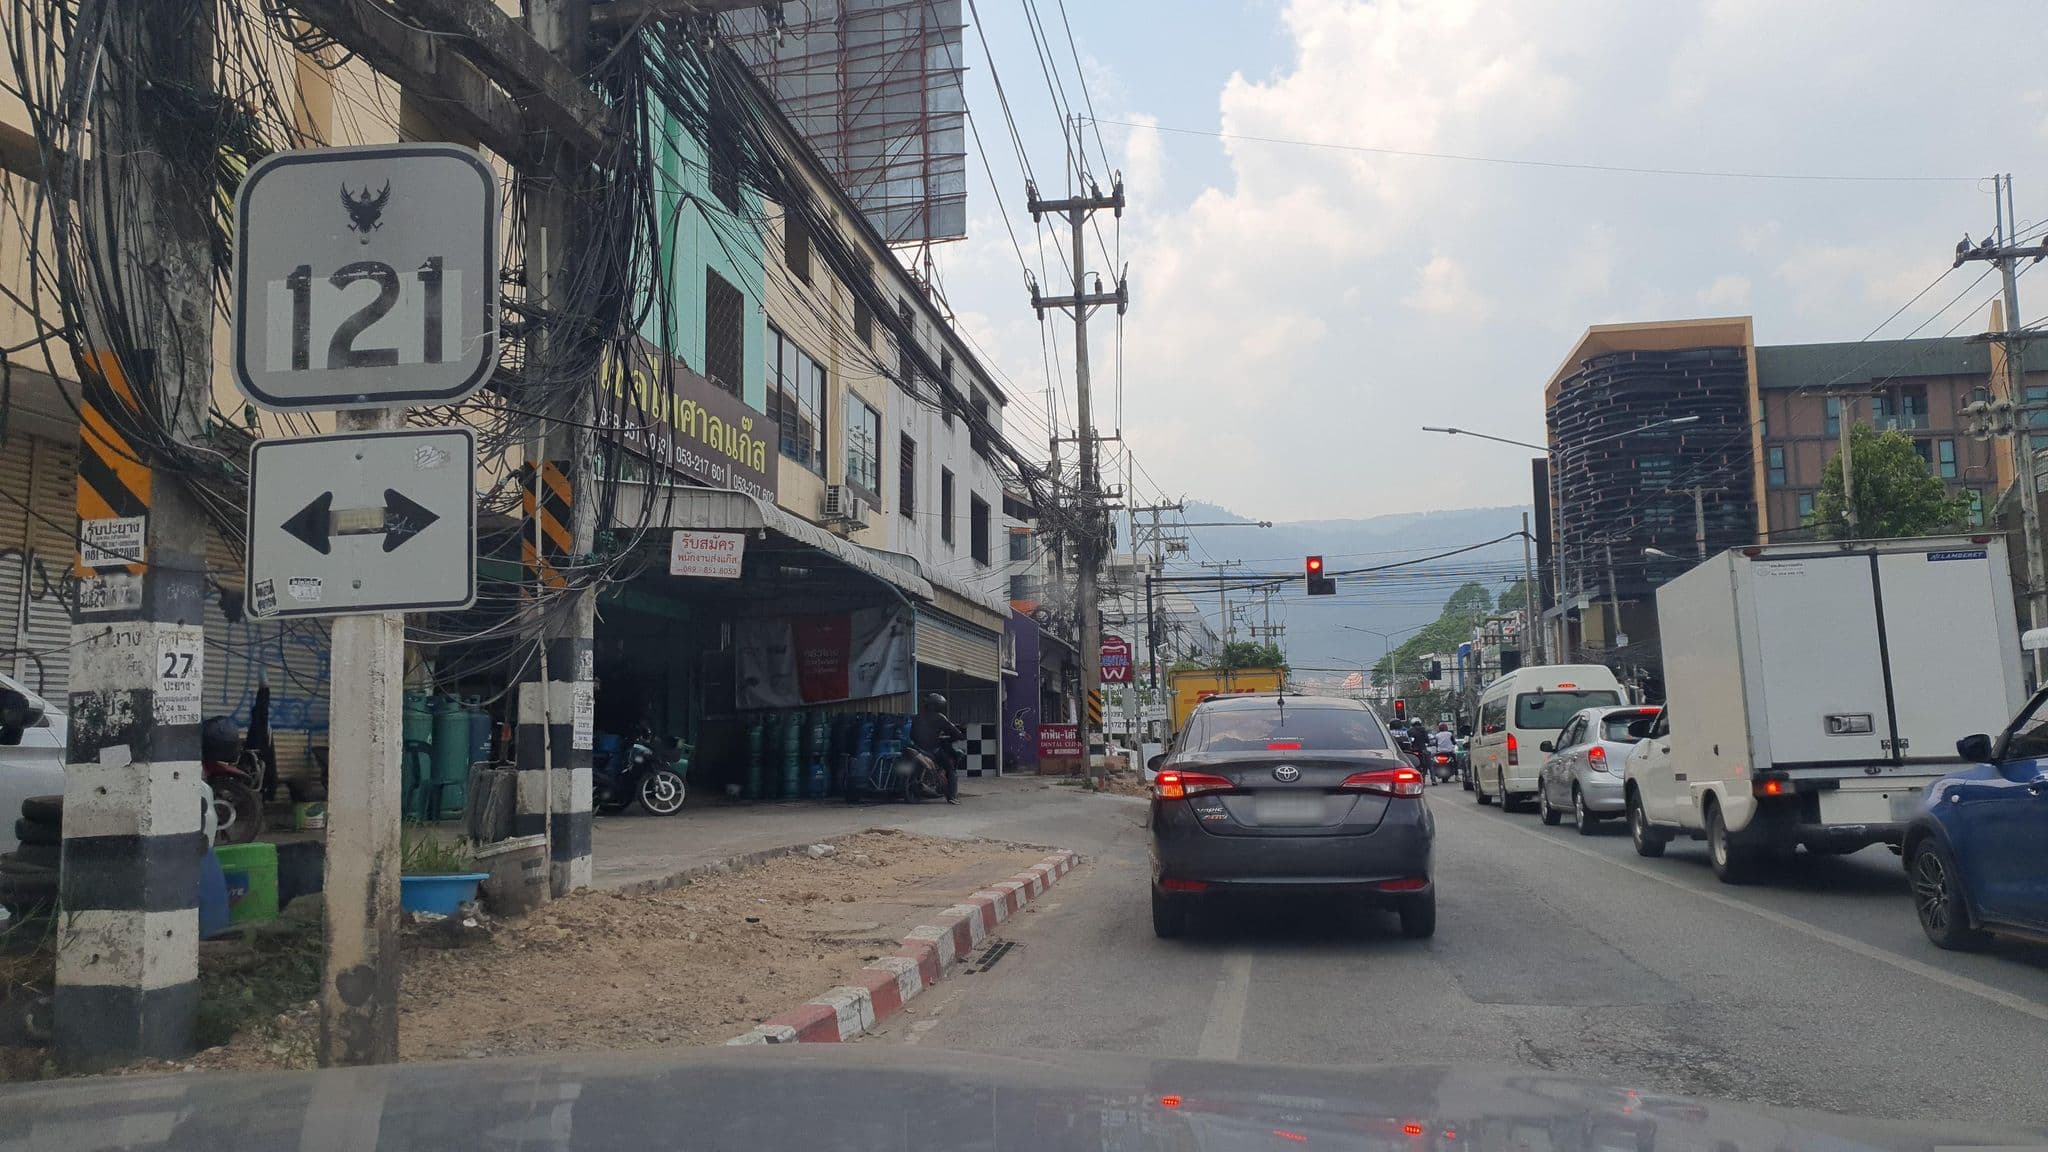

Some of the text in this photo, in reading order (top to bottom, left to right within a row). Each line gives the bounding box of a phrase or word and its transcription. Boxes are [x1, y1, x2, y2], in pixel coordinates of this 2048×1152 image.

[286, 256, 443, 371] 121
[676, 446, 710, 476] 053-217
[711, 463, 726, 483] 601
[682, 533, 736, 551] รับสมัคร
[163, 652, 194, 679] 27
